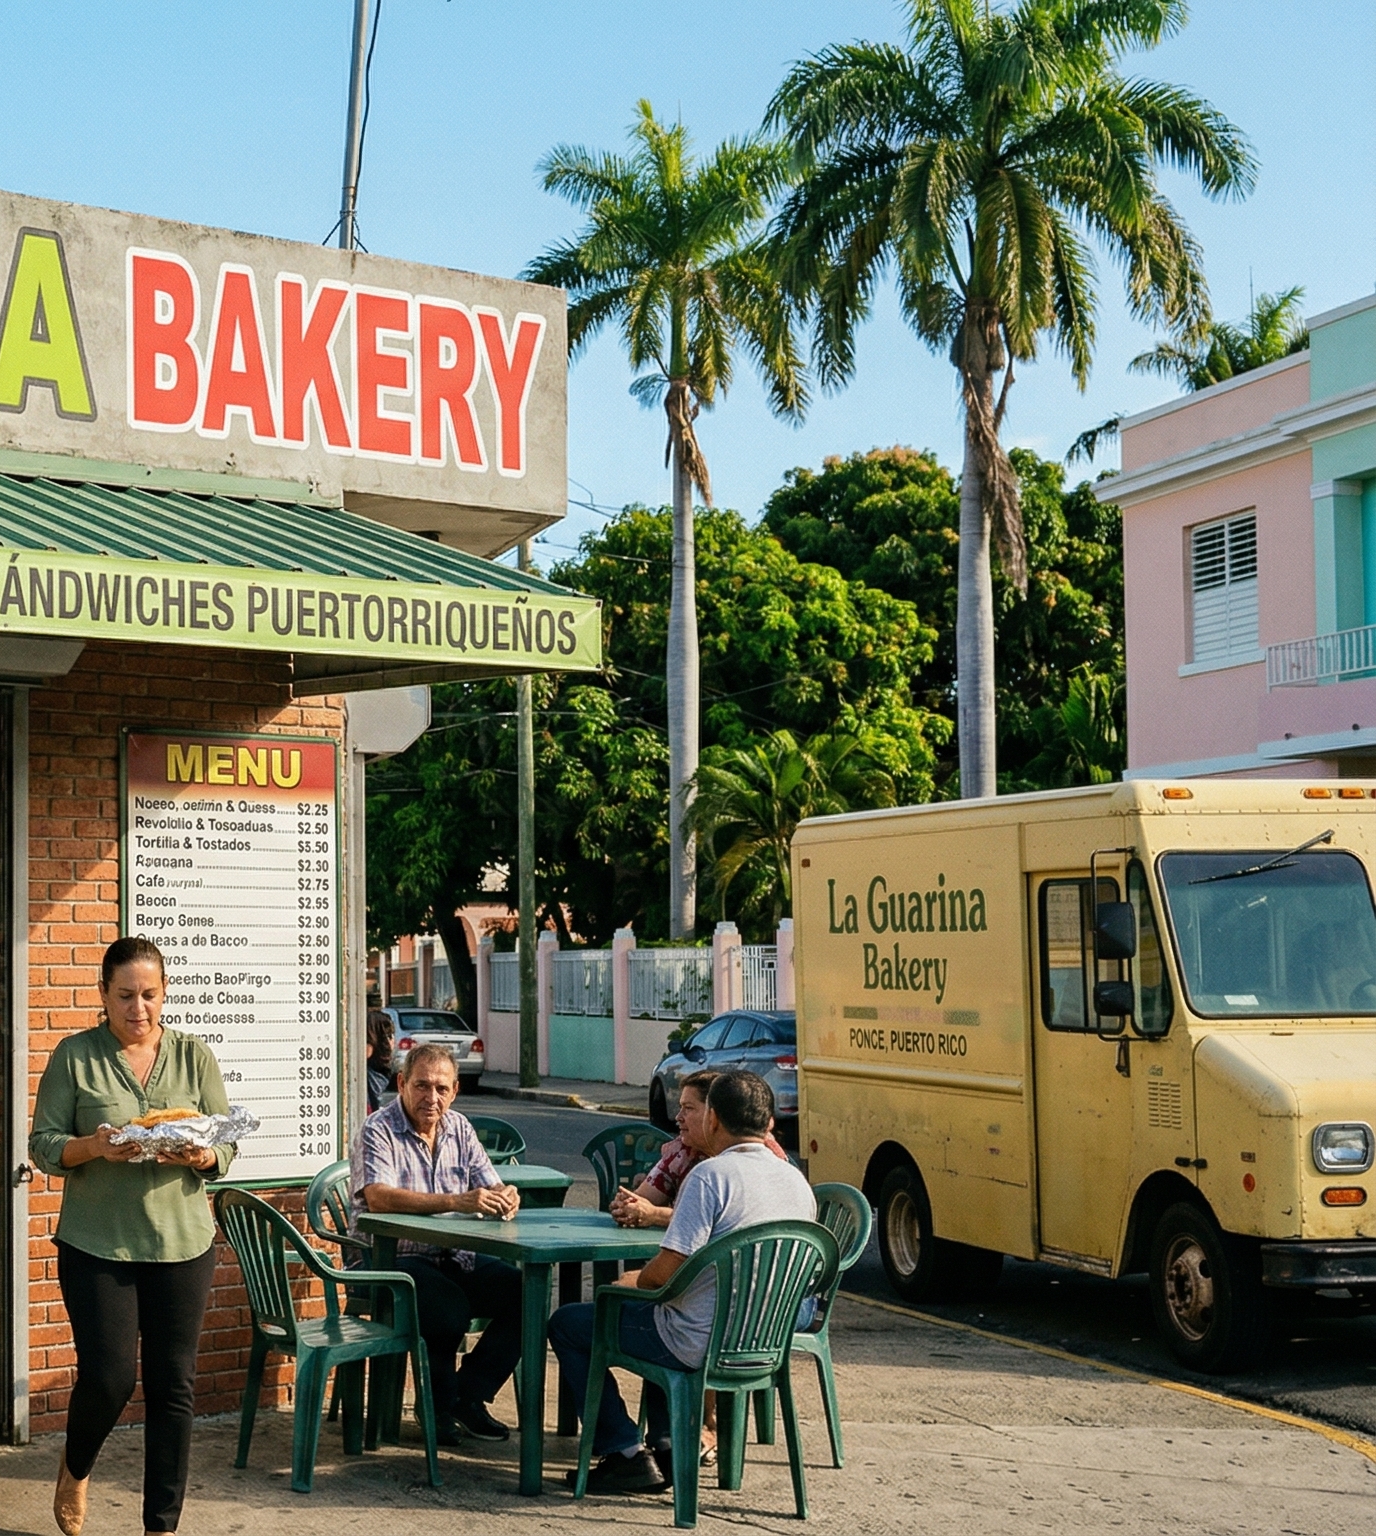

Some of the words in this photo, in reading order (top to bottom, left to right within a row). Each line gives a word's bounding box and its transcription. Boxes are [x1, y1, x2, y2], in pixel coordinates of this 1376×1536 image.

[126, 246, 545, 478] BAKERY
[248, 585, 576, 655] PUERTORRIQUEÑOS
[167, 743, 302, 788] MENU
[226, 800, 235, 812] &
[297, 801, 329, 817] $2.25
[196, 817, 205, 830] &
[297, 821, 329, 836] $2.50
[183, 836, 192, 849] &
[196, 837, 251, 851] Tostados
[297, 877, 330, 892] $2.75
[827, 878, 860, 934] La
[867, 873, 988, 934] Guarina
[181, 936, 189, 946] a
[298, 971, 331, 986] $2.90
[863, 943, 947, 1004] Bakery
[198, 992, 214, 1004] de
[298, 990, 330, 1005] $3.90
[298, 1009, 330, 1024] $3.00
[849, 1028, 888, 1053] PONCE,
[890, 1030, 935, 1054] PUERTO
[938, 1033, 968, 1056] RICO
[298, 1046, 331, 1062] $8.90
[299, 1122, 331, 1139] $3.90
[299, 1141, 331, 1157] $4.00
